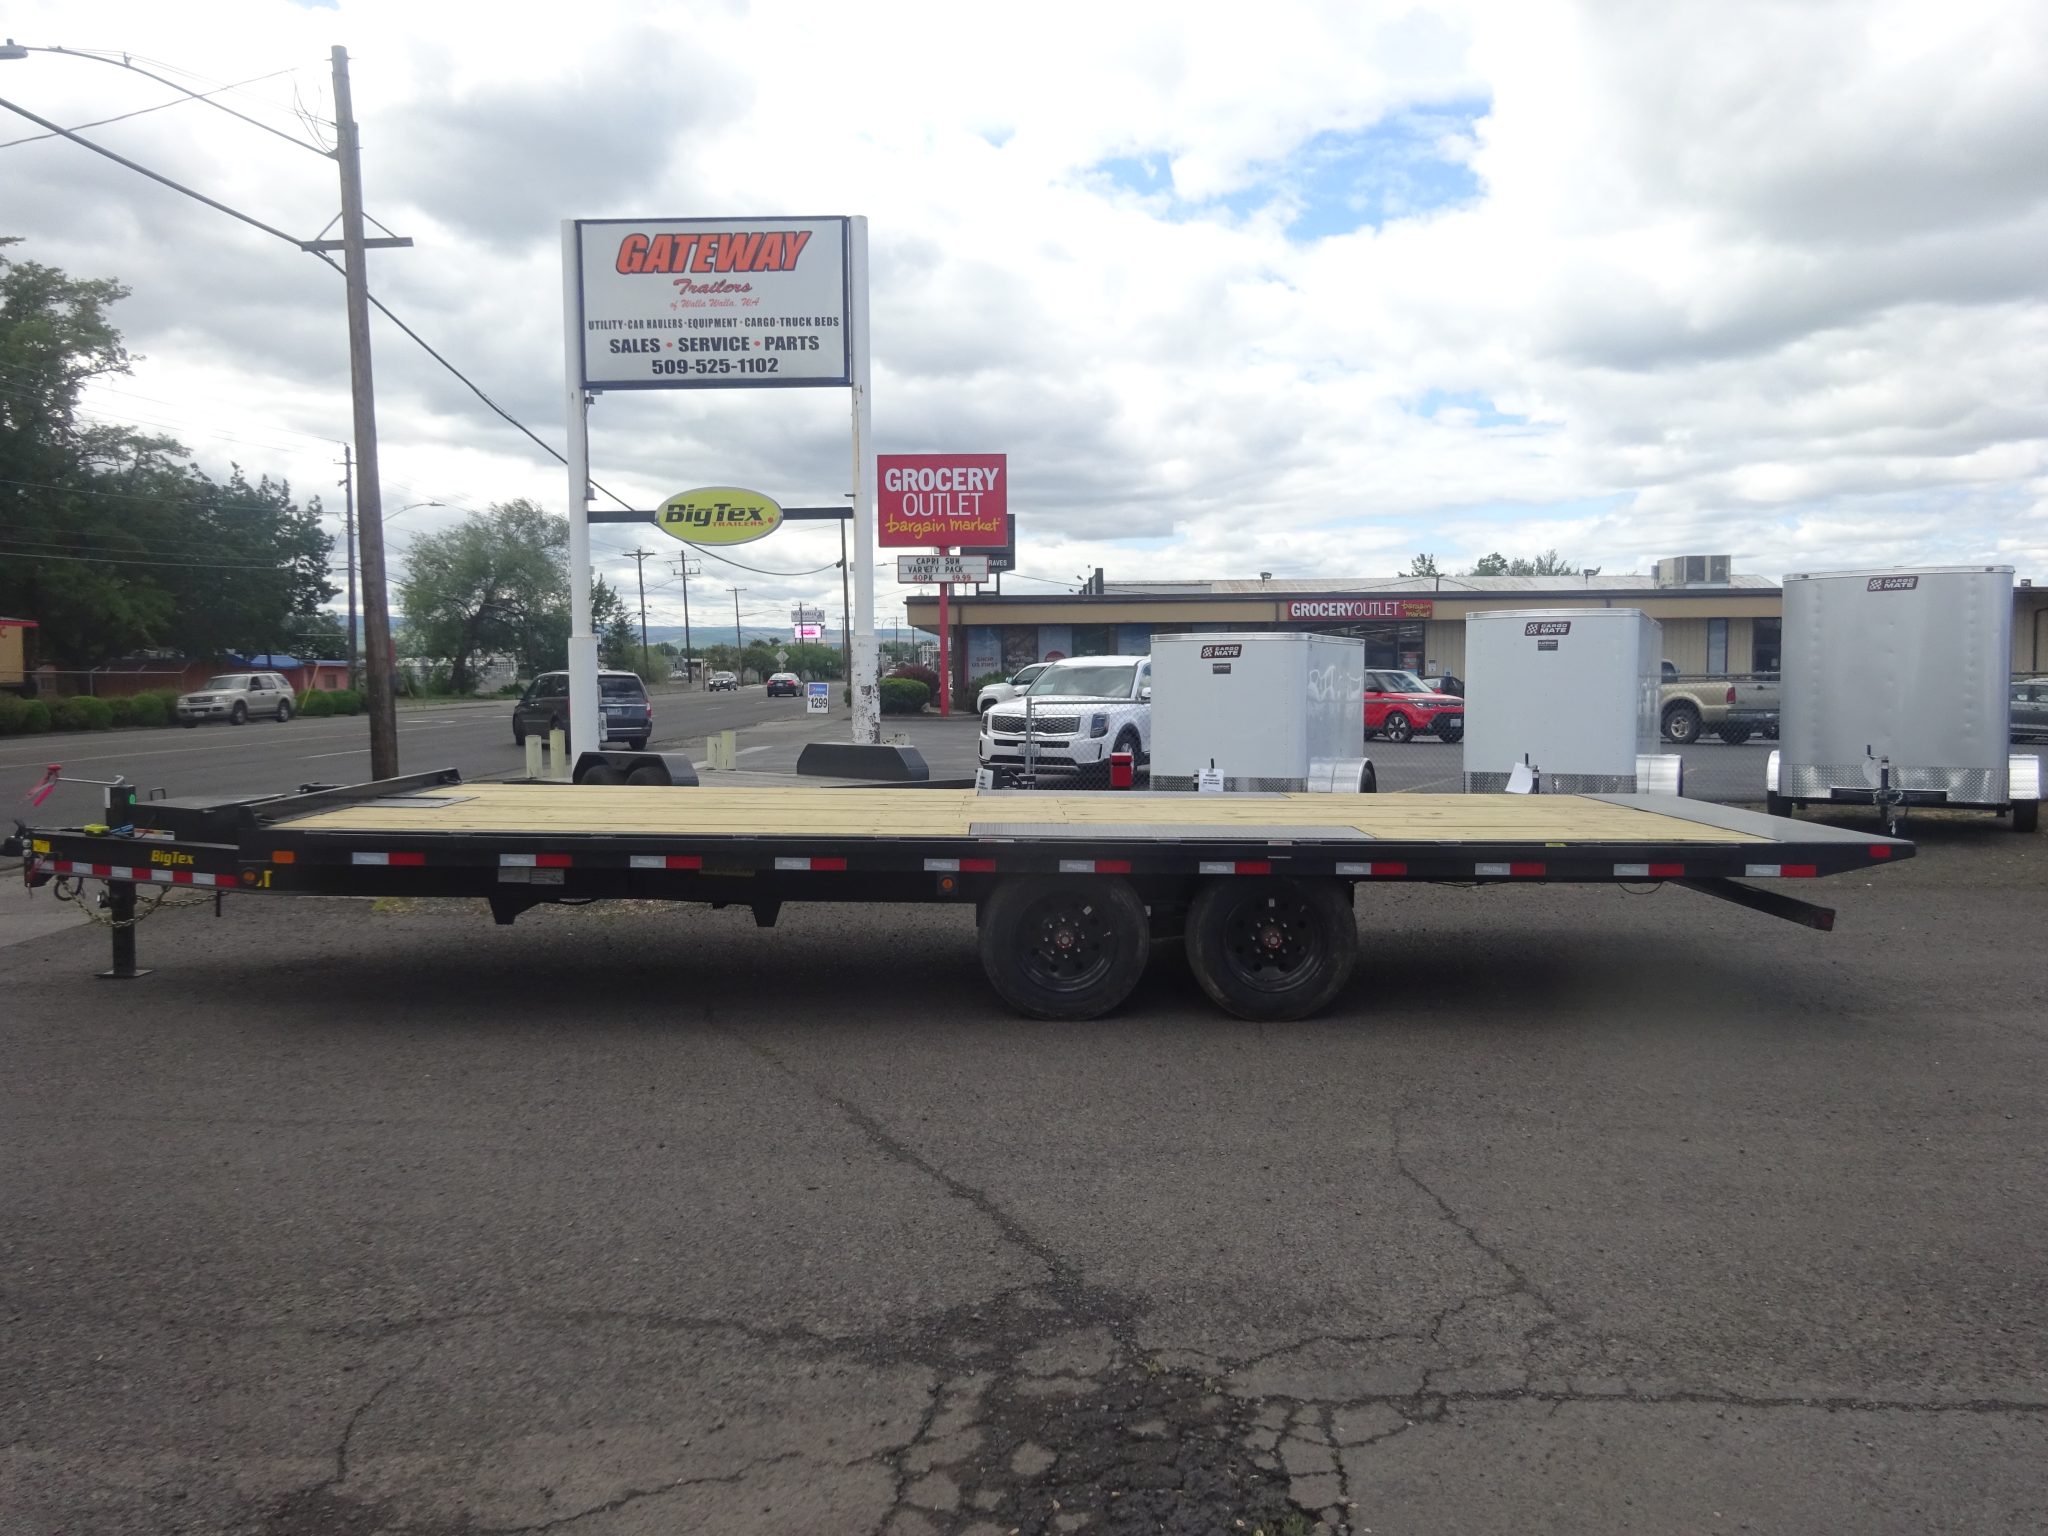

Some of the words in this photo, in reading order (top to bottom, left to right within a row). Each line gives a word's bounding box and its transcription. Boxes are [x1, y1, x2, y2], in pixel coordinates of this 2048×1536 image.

[615, 230, 813, 275] GATEWAY
[681, 299, 706, 308] Walla
[741, 297, 760, 307] WA
[588, 320, 623, 331] UTILITY
[627, 320, 644, 330] CAR
[646, 319, 683, 330] HAULERS
[688, 318, 738, 329] EQUIPMENT
[744, 318, 776, 328] CARGO
[779, 317, 812, 328] TRUCK
[814, 317, 839, 327] BEDS
[609, 338, 661, 354] SALES
[678, 336, 750, 352] SERVICE
[764, 335, 820, 351] PARTS
[652, 357, 779, 375] 509-525-1102
[884, 467, 1000, 492] GROCERY
[902, 492, 984, 516] OUTLET
[665, 503, 764, 527] BigTex
[885, 513, 946, 539] bargain
[949, 517, 1000, 532] market
[916, 557, 939, 565] CAPRI
[151, 850, 195, 866] BigTex
